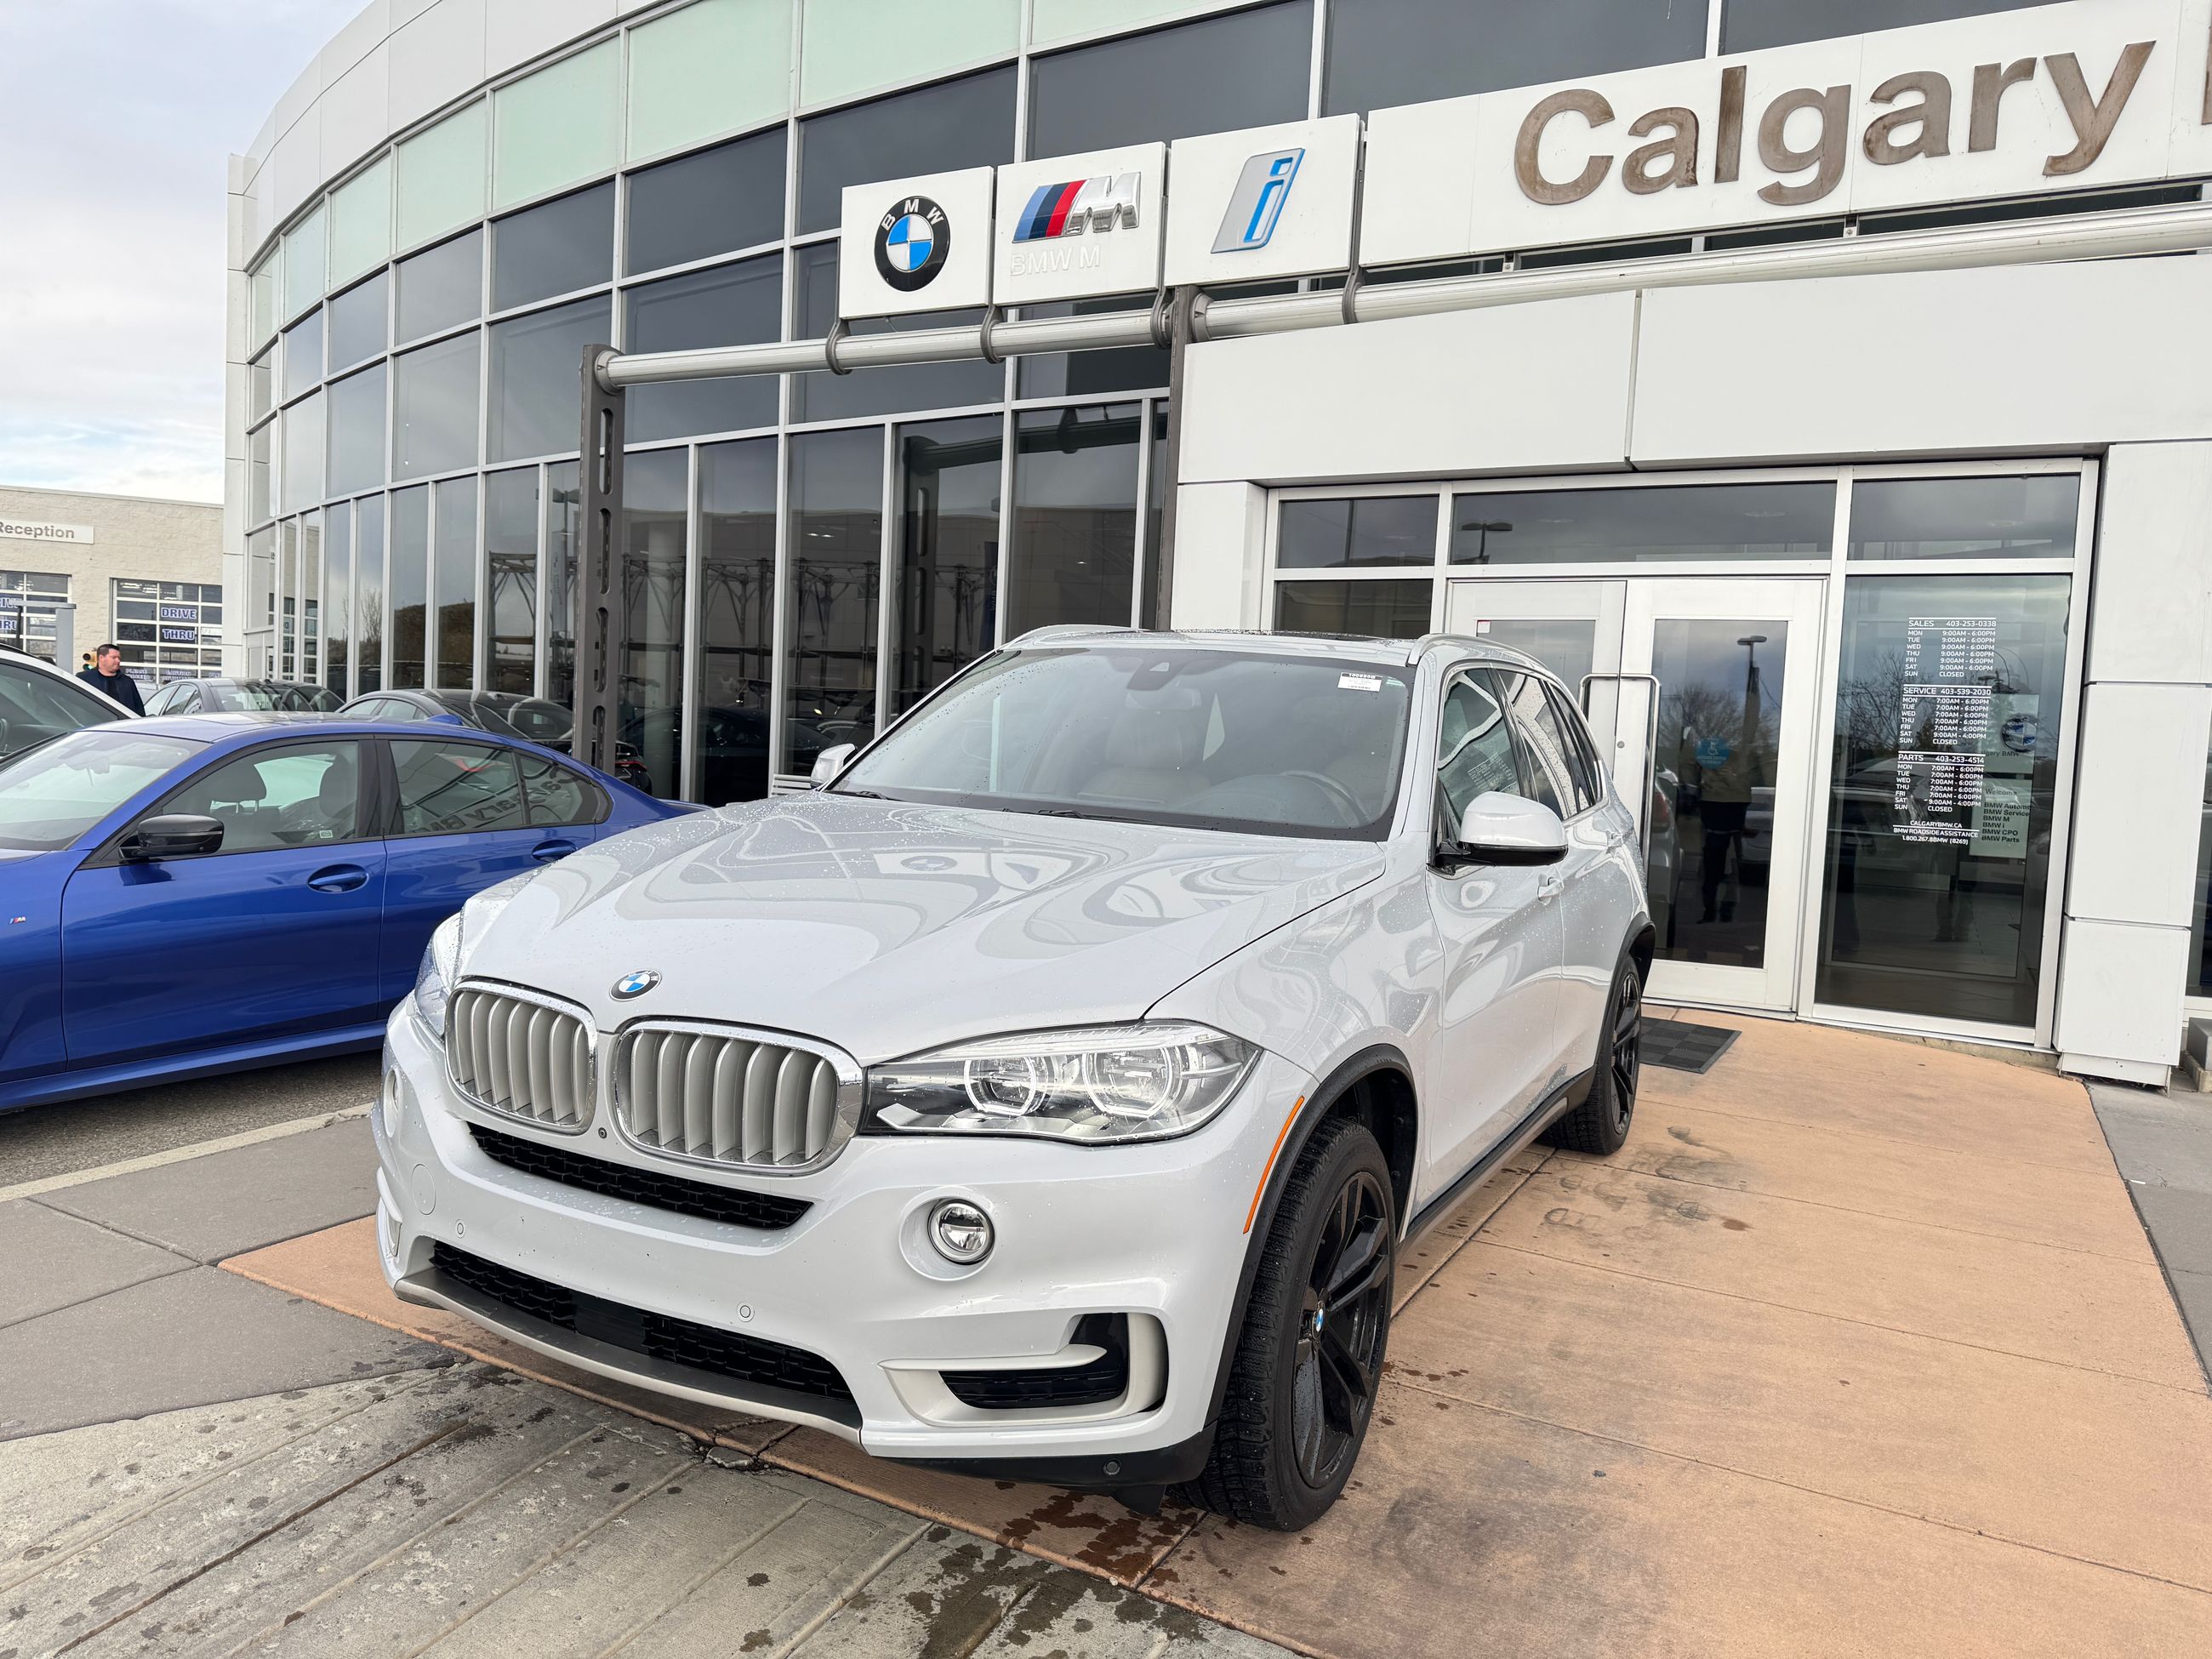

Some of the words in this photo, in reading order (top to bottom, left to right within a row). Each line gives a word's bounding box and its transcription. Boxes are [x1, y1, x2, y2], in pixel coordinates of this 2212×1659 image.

[1514, 40, 2157, 206] Calgary
[881, 198, 944, 231] BMW
[1010, 247, 1073, 276] BMW
[1080, 245, 1100, 269] M
[161, 607, 197, 620] DRIVE
[162, 628, 196, 641] THRU
[1910, 820, 1962, 829] CALGARYBMW.CA
